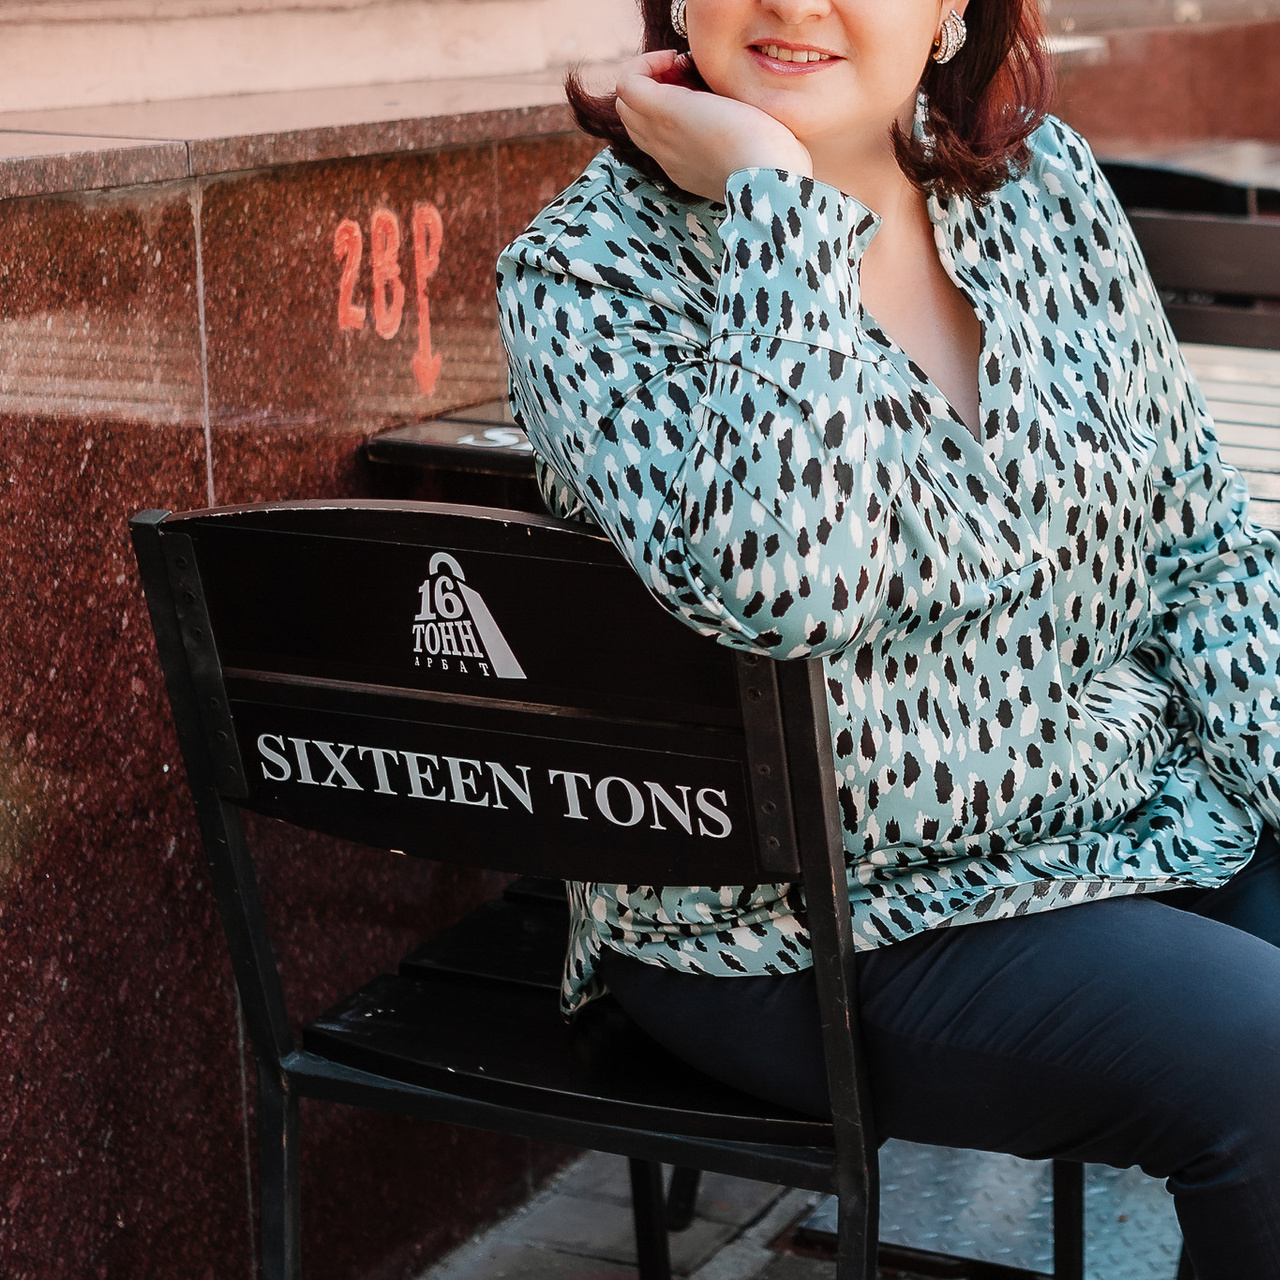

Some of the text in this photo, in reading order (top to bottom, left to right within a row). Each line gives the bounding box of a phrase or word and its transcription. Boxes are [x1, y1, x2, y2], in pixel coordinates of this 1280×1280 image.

[414, 575, 464, 621] 16
[412, 620, 484, 658] ТОНН
[414, 656, 490, 677] АРБАТ
[256, 733, 733, 839] SIXTEEN TONS
